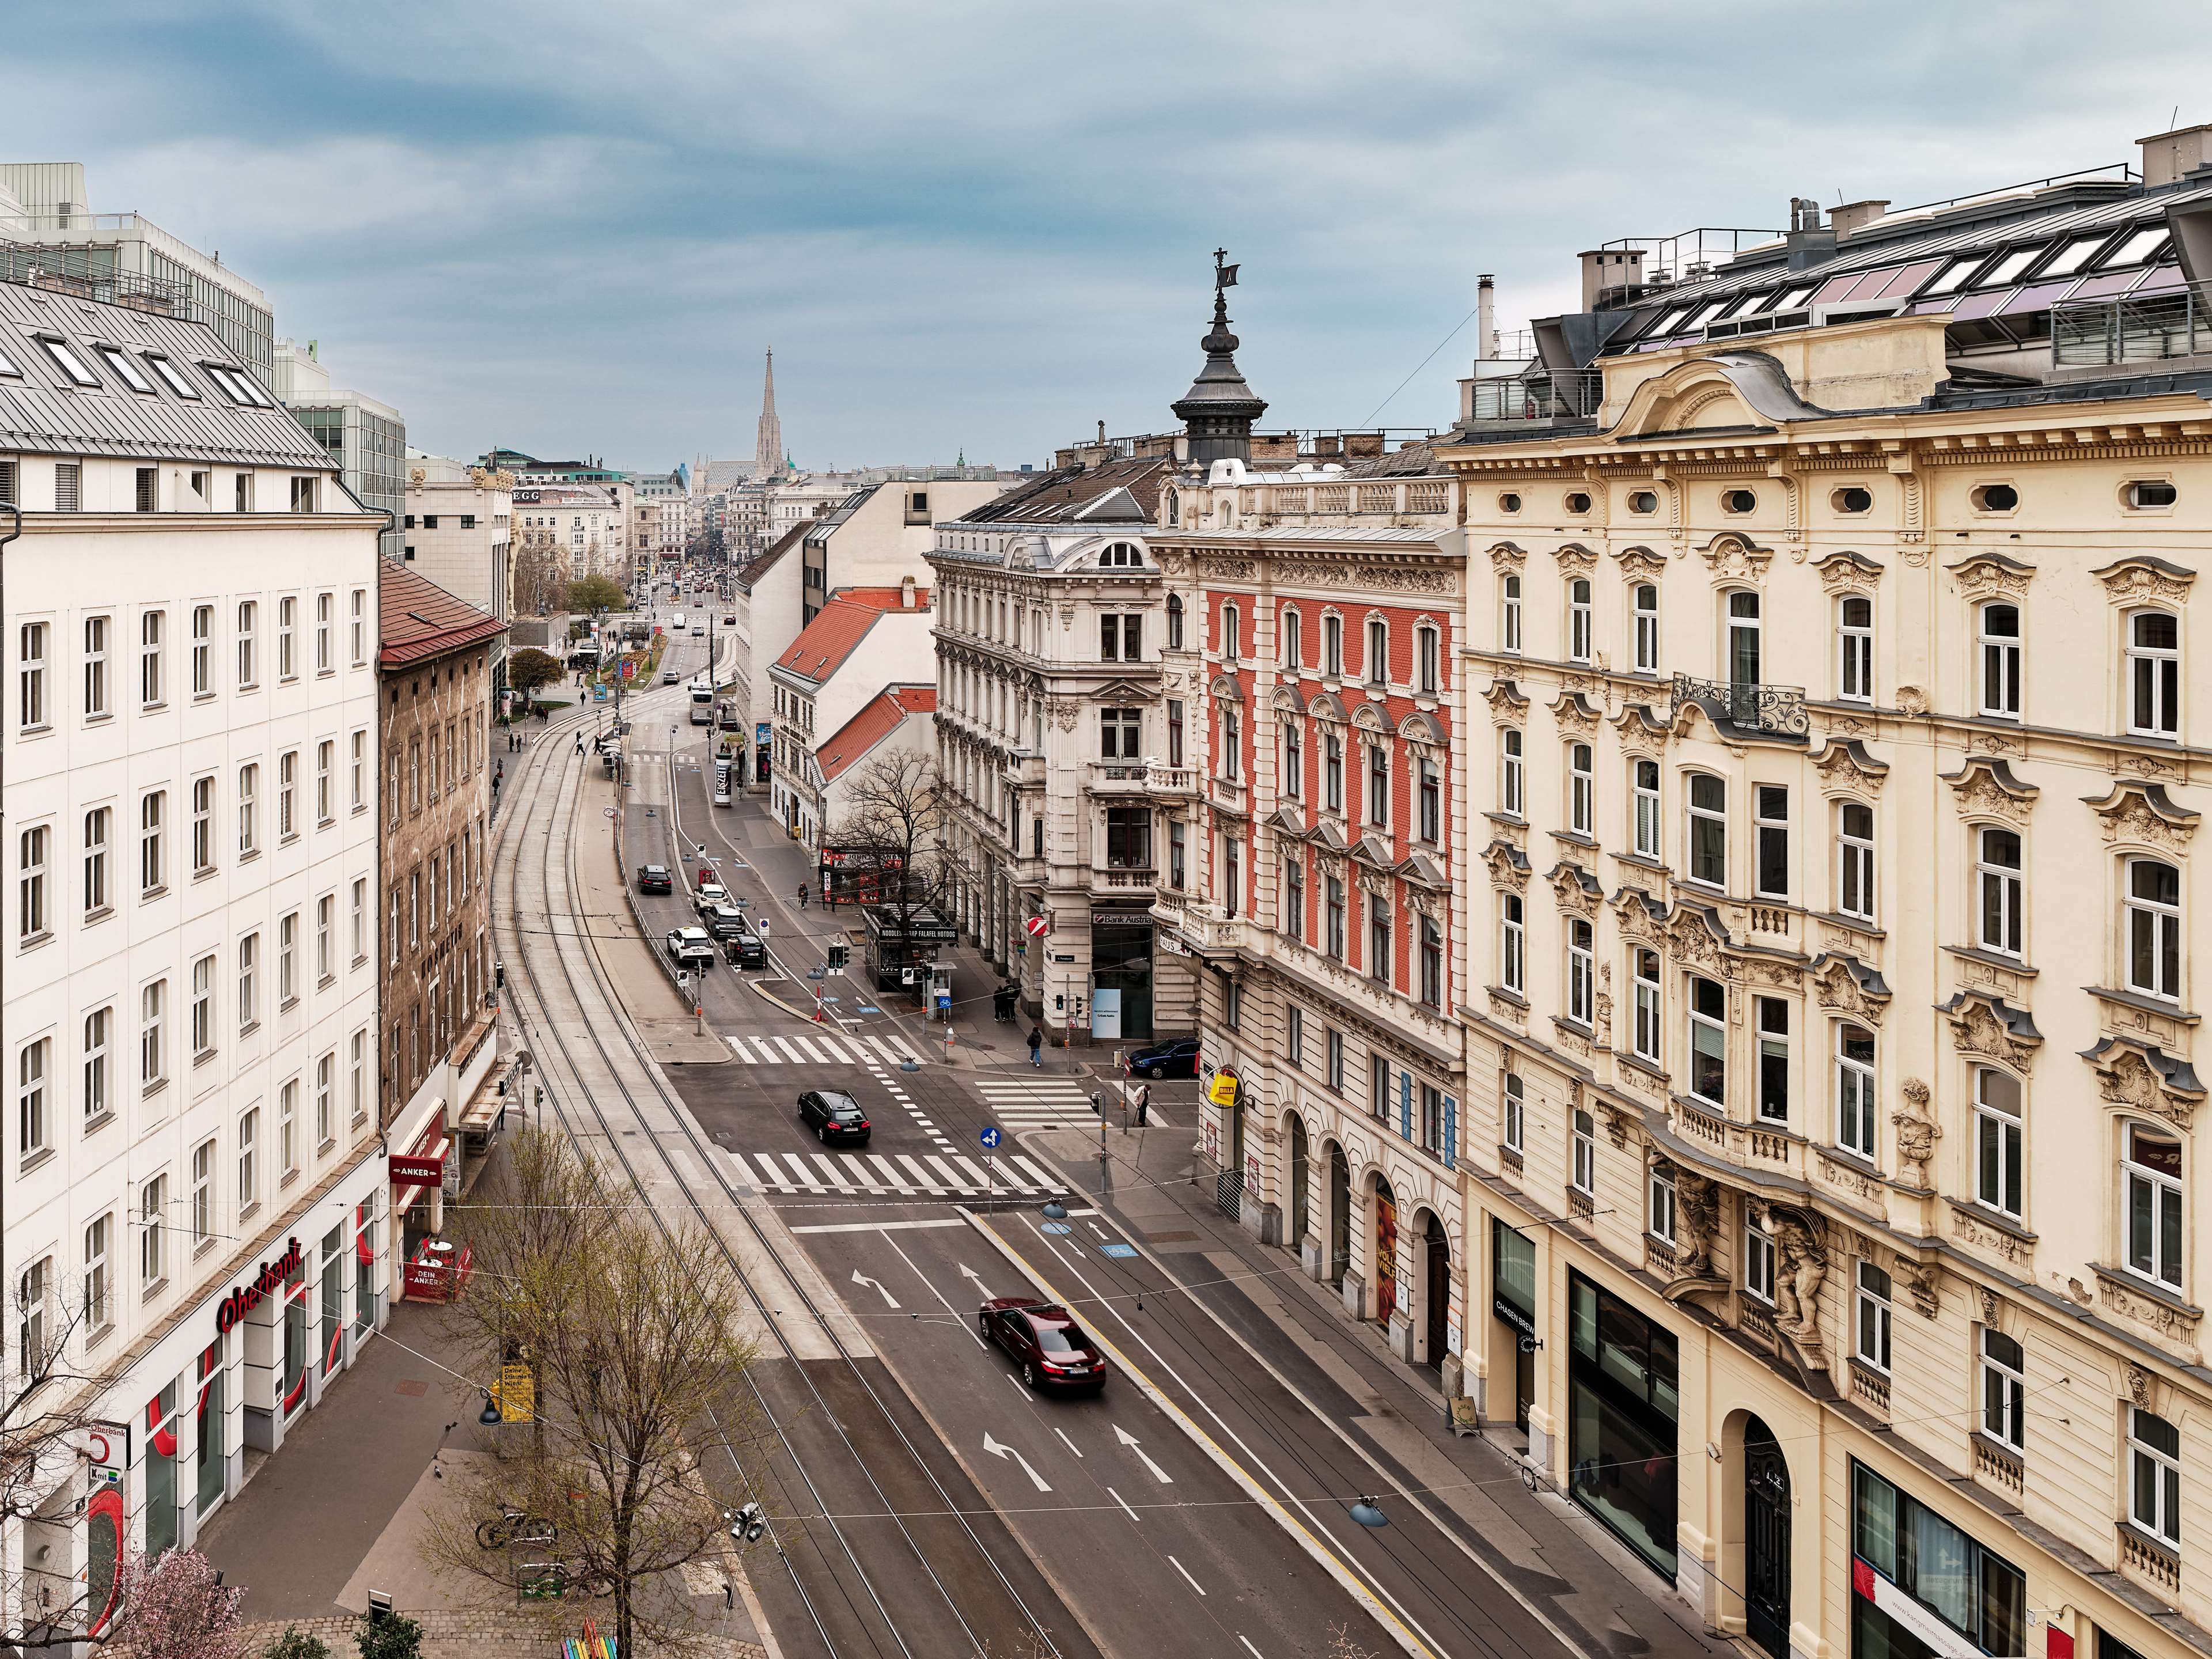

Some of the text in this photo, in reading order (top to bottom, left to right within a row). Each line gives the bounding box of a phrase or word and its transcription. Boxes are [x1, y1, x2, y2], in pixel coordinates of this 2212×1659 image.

[1105, 915, 1152, 924] Bank Austria
[415, 1138, 428, 1156] ANKER
[401, 1168, 429, 1177] ANKER
[418, 1270, 435, 1278] DEIN
[217, 1237, 302, 1334] Oberbank
[414, 1277, 438, 1286] ANKER
[1496, 1301, 1535, 1334] CHASEN BREW
[1520, 1337, 1535, 1349] CHASEN
[1456, 1404, 1471, 1419] CHASEN
[91, 1424, 126, 1437] Oberbank
